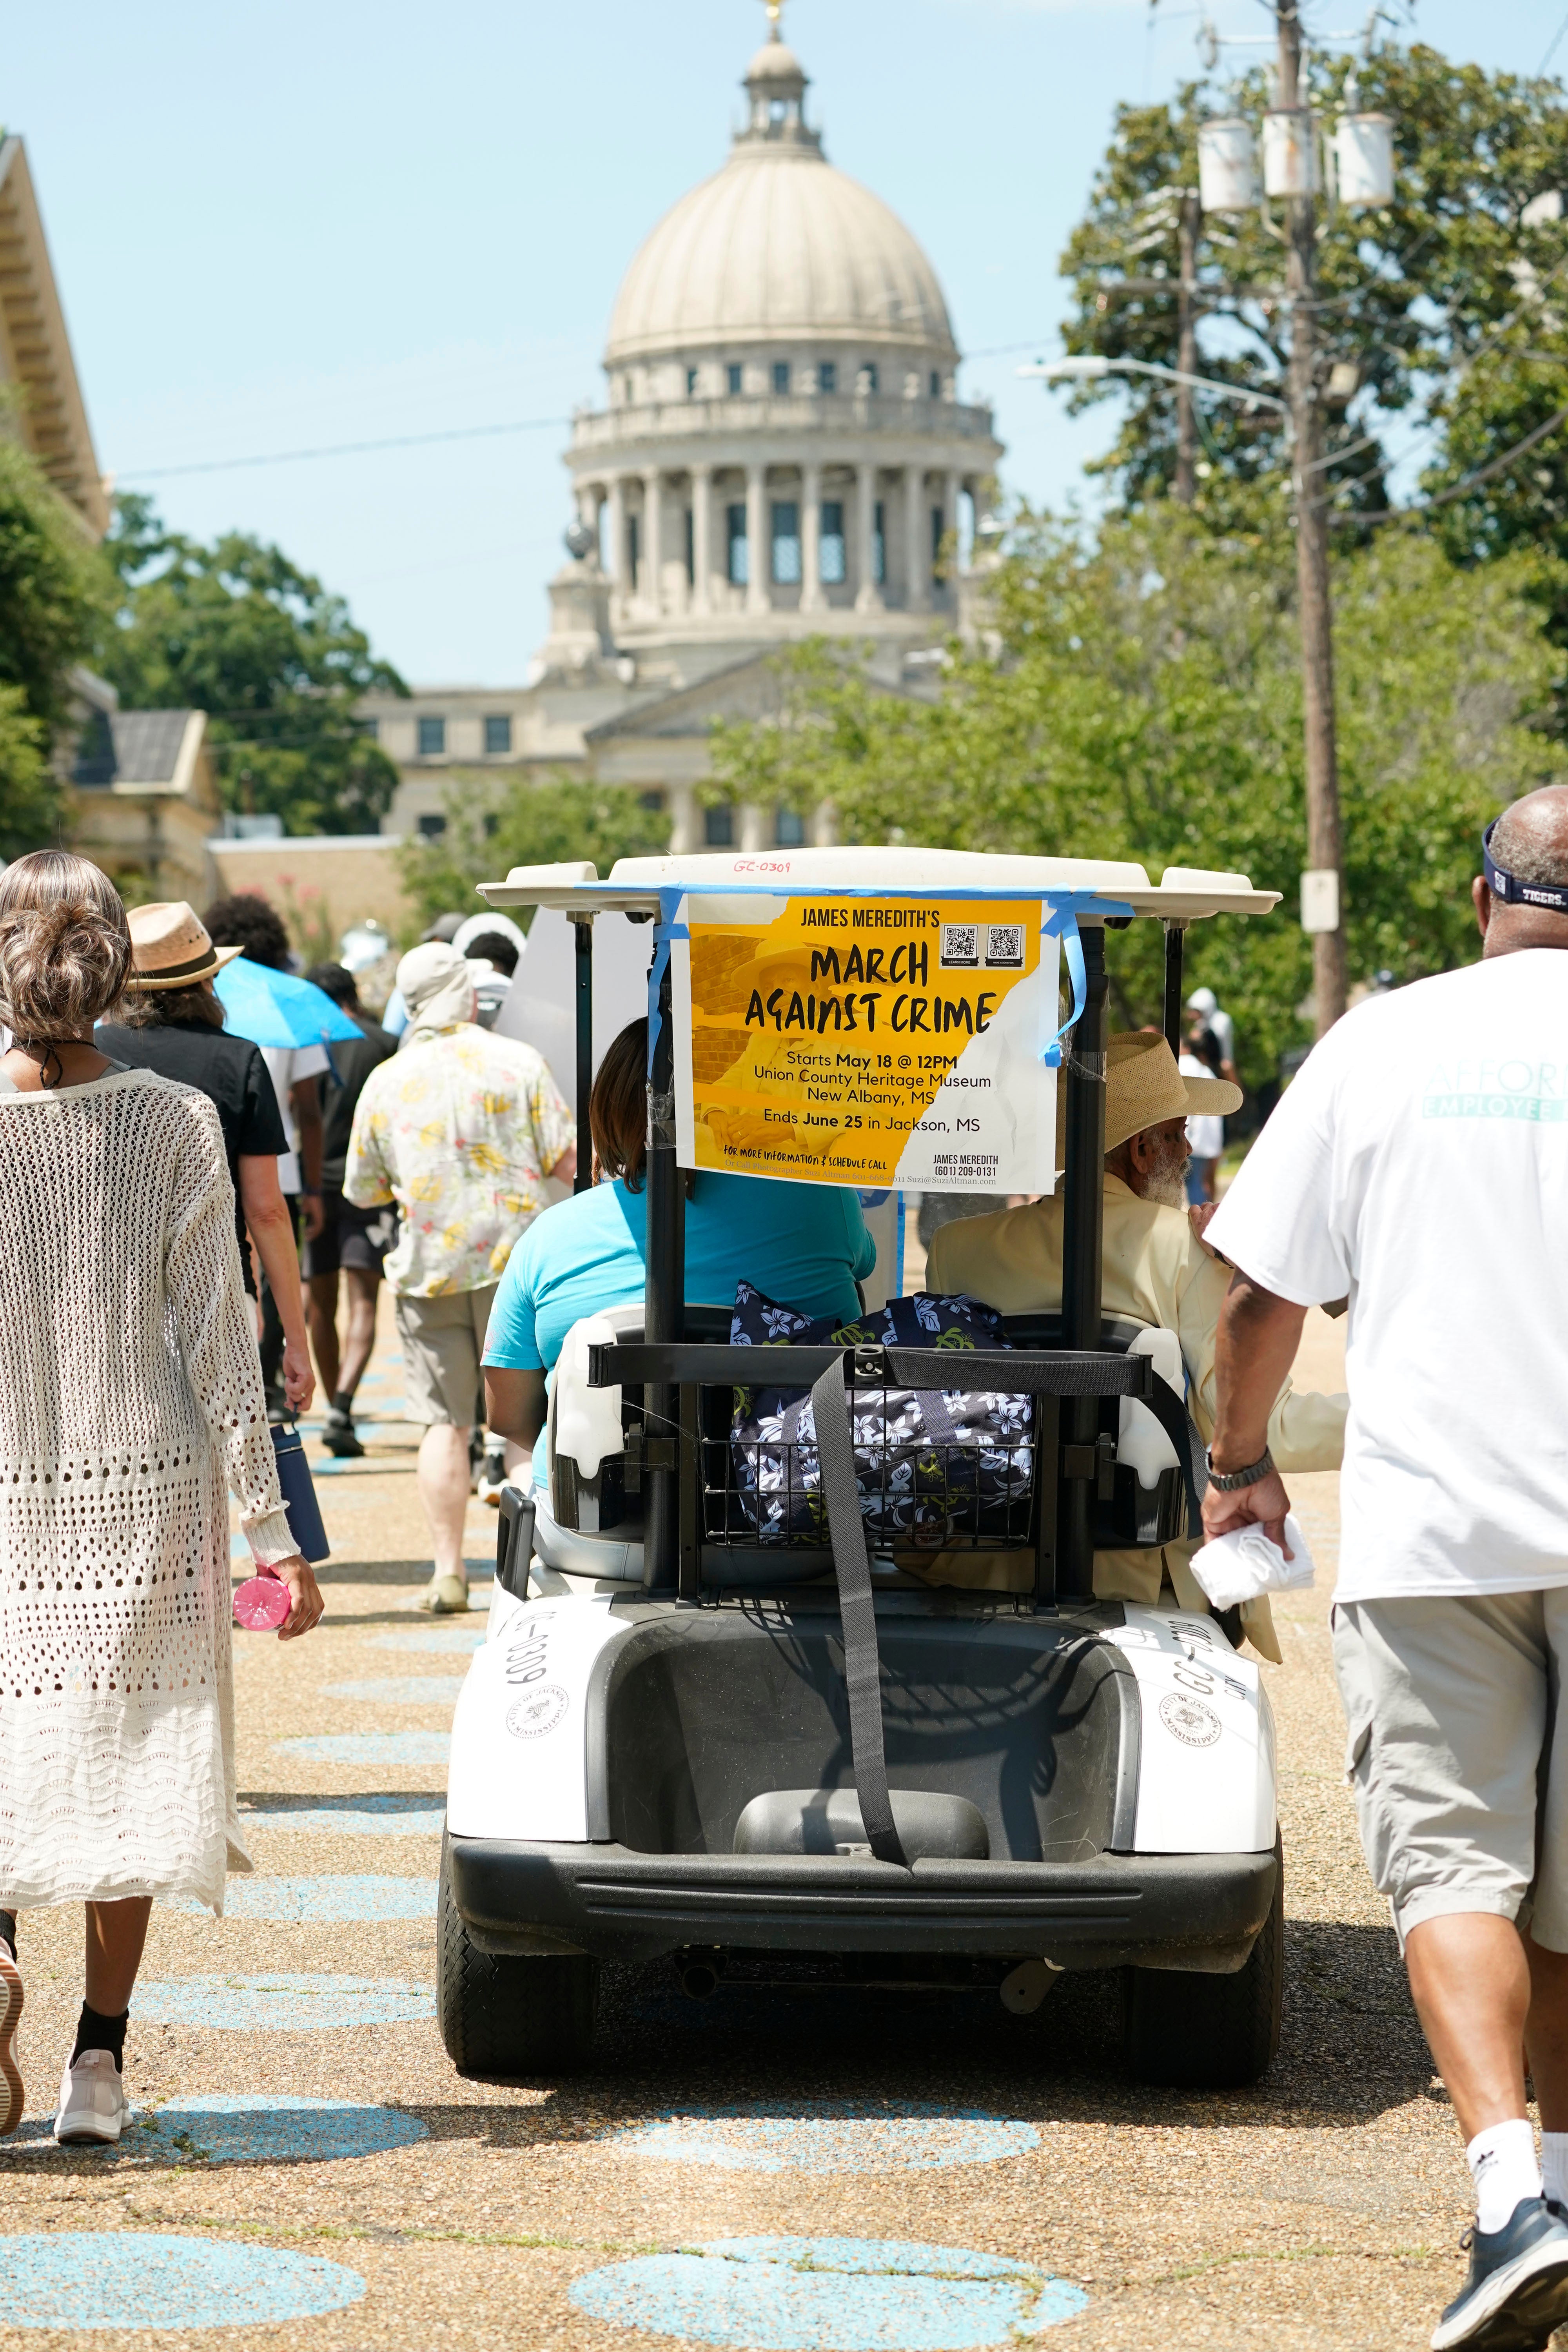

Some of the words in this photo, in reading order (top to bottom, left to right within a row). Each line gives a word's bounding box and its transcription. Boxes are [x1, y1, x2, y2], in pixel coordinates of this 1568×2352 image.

[733, 860, 790, 873] GC-0309
[1522, 888, 1562, 906] TIGERS
[801, 908, 848, 927] JAMES
[853, 909, 940, 928] MEREDITH'S
[811, 941, 928, 987] MARCH
[745, 988, 882, 1034] AGAINST
[891, 992, 997, 1035] CRIME
[786, 1051, 831, 1066] Starts
[836, 1054, 871, 1071] May
[877, 1055, 892, 1068] 18
[897, 1055, 912, 1069] @
[917, 1055, 957, 1069] 12PM
[754, 1065, 794, 1081] Union
[799, 1069, 853, 1087] County
[858, 1072, 924, 1089] Heritage
[929, 1074, 991, 1087] Museum
[1424, 1060, 1568, 1096] AFFOR
[808, 1087, 842, 1102] New
[847, 1089, 905, 1107] Albany,
[911, 1091, 935, 1105] MS
[1424, 1097, 1552, 1120] EMPLOYEE
[764, 1109, 798, 1124] Ends
[802, 1112, 838, 1127] June
[844, 1115, 863, 1128] 25
[868, 1116, 880, 1129] in
[885, 1117, 950, 1132] Jackson,
[956, 1118, 980, 1131] MS
[723, 1144, 738, 1156] FOR
[740, 1148, 762, 1159] MORE
[820, 1154, 826, 1167] &
[829, 1156, 867, 1169] SCHEDULE
[868, 1160, 887, 1170] CALL
[933, 1154, 958, 1164] JAMES
[960, 1155, 998, 1165] MEREDITH
[736, 1160, 751, 1169] Call
[752, 1162, 803, 1175] Photographer
[804, 1168, 820, 1176] Suzi
[822, 1170, 850, 1180] Altman
[852, 1172, 905, 1183] 601-668-9611
[907, 1176, 996, 1185] Suzi@SuziAltman.com
[935, 1166, 956, 1176] (601)
[958, 1167, 996, 1176] 209-0131
[505, 1611, 557, 1684] GC-0309
[1168, 1621, 1215, 1695] GC-0309
[509, 1702, 522, 1720] CITY
[523, 1693, 533, 1702] OF
[536, 1688, 565, 1702] JACKSON
[1163, 1696, 1177, 1710] CITY
[1191, 1700, 1219, 1730] JACKSON
[513, 1710, 563, 1736] MISSISSIPPI
[1165, 1718, 1215, 1744] MISSISSIPPI
